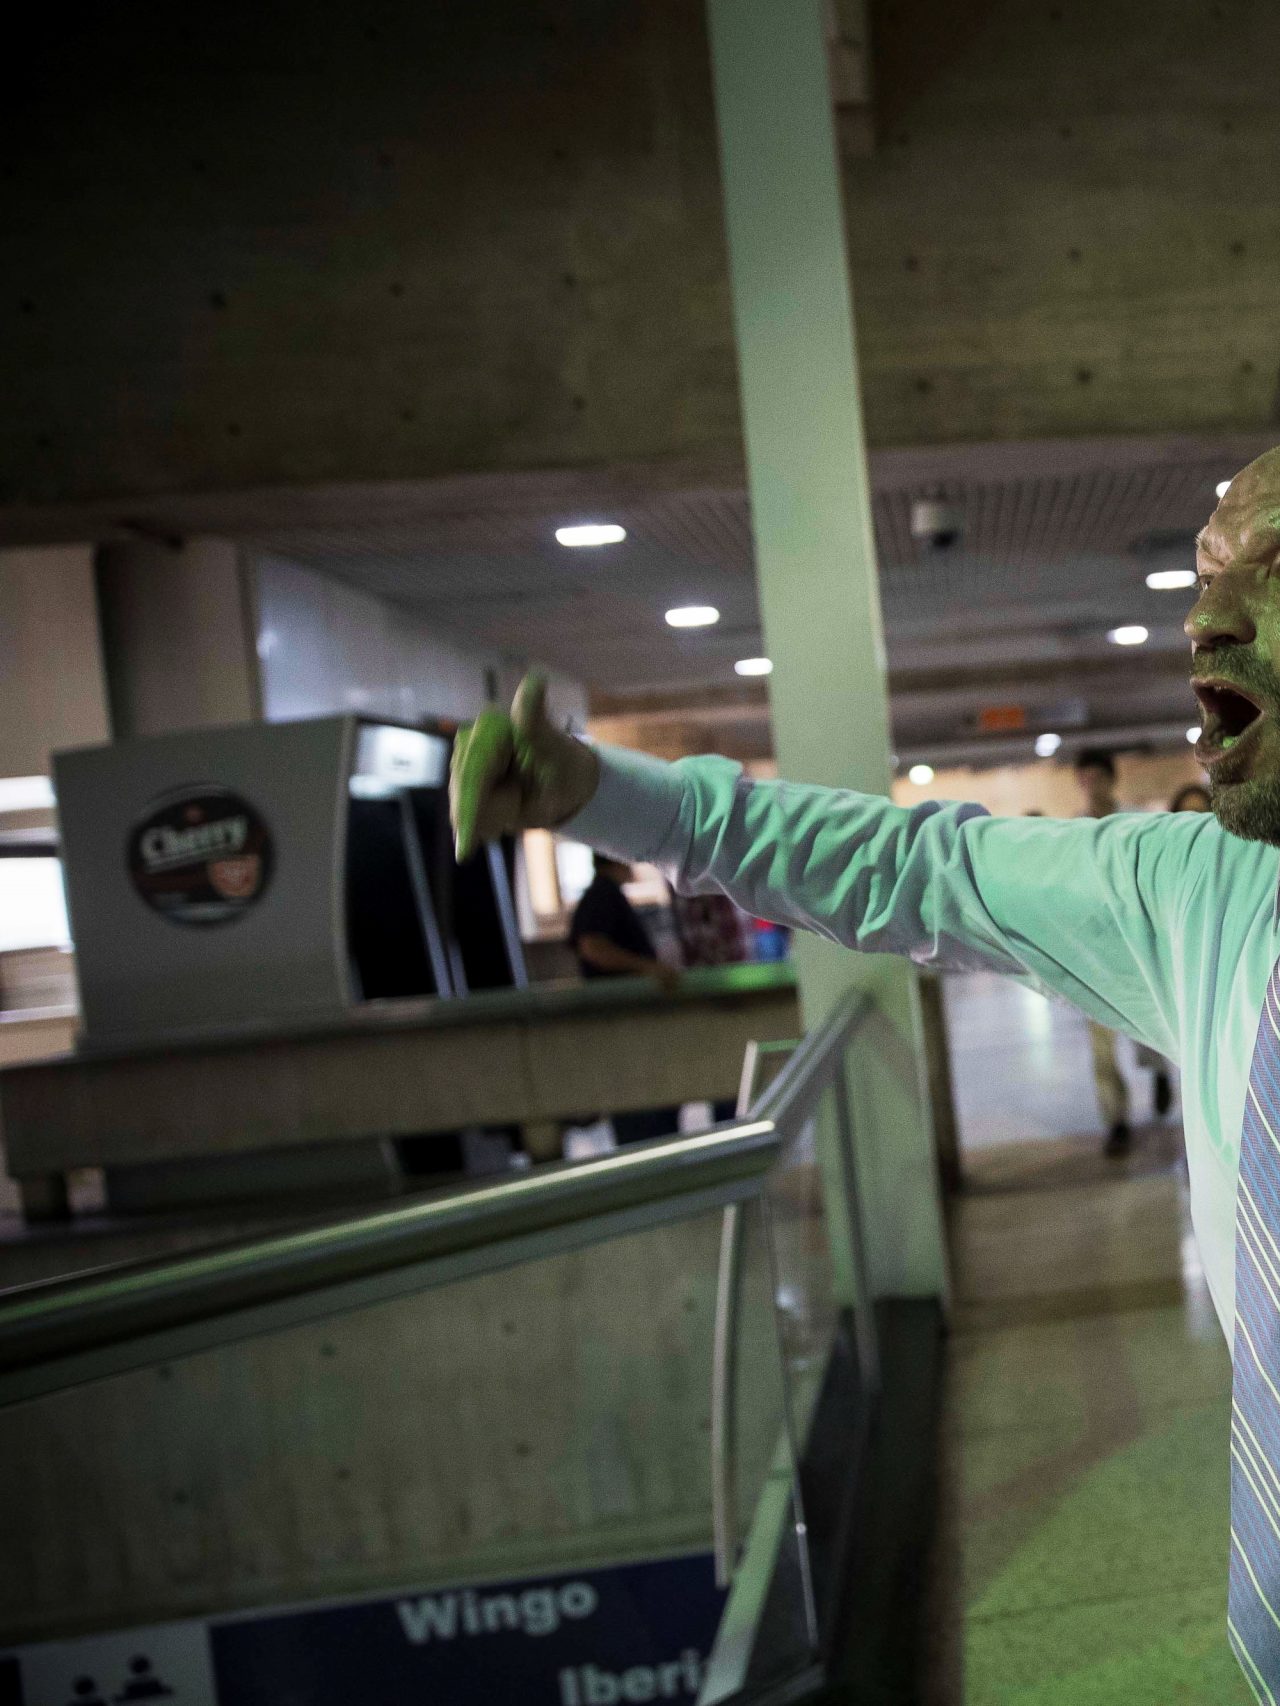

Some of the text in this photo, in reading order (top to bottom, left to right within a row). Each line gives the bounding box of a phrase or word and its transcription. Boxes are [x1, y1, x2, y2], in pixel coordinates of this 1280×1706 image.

[139, 814, 250, 870] Cherry
[396, 1581, 600, 1645] Wingo
[557, 1649, 708, 1706] Iberi
